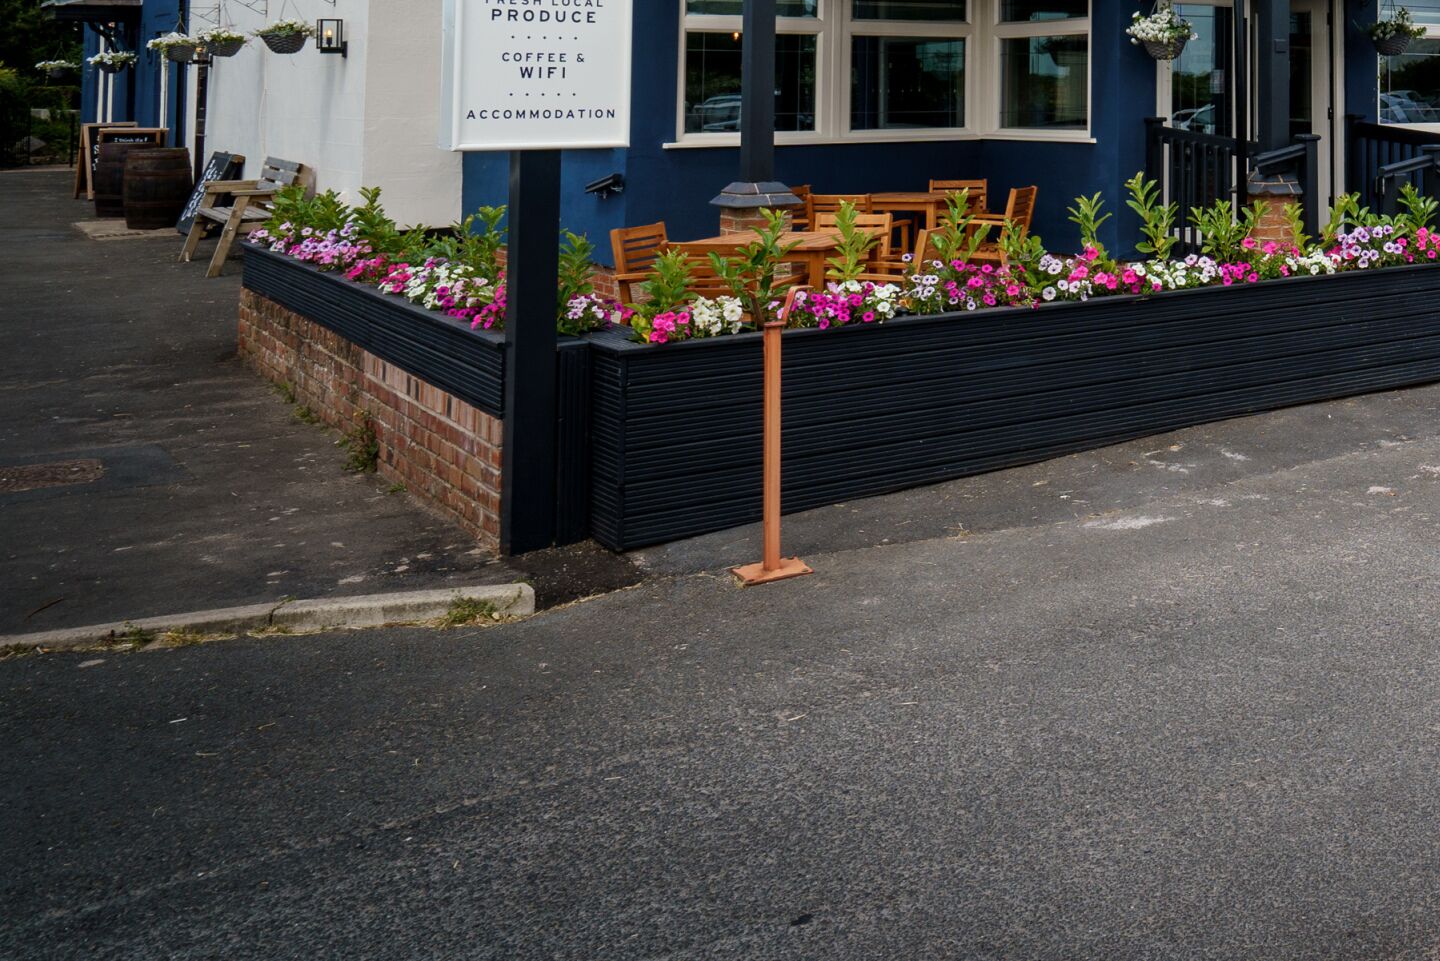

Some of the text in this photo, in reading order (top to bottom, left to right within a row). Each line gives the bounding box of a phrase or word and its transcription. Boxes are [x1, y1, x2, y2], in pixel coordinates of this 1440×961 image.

[491, 8, 597, 24] PRODUCE
[501, 52, 585, 63] COFFEE &
[519, 66, 567, 79] WIFI
[466, 109, 616, 120] ACCOMMODATION
